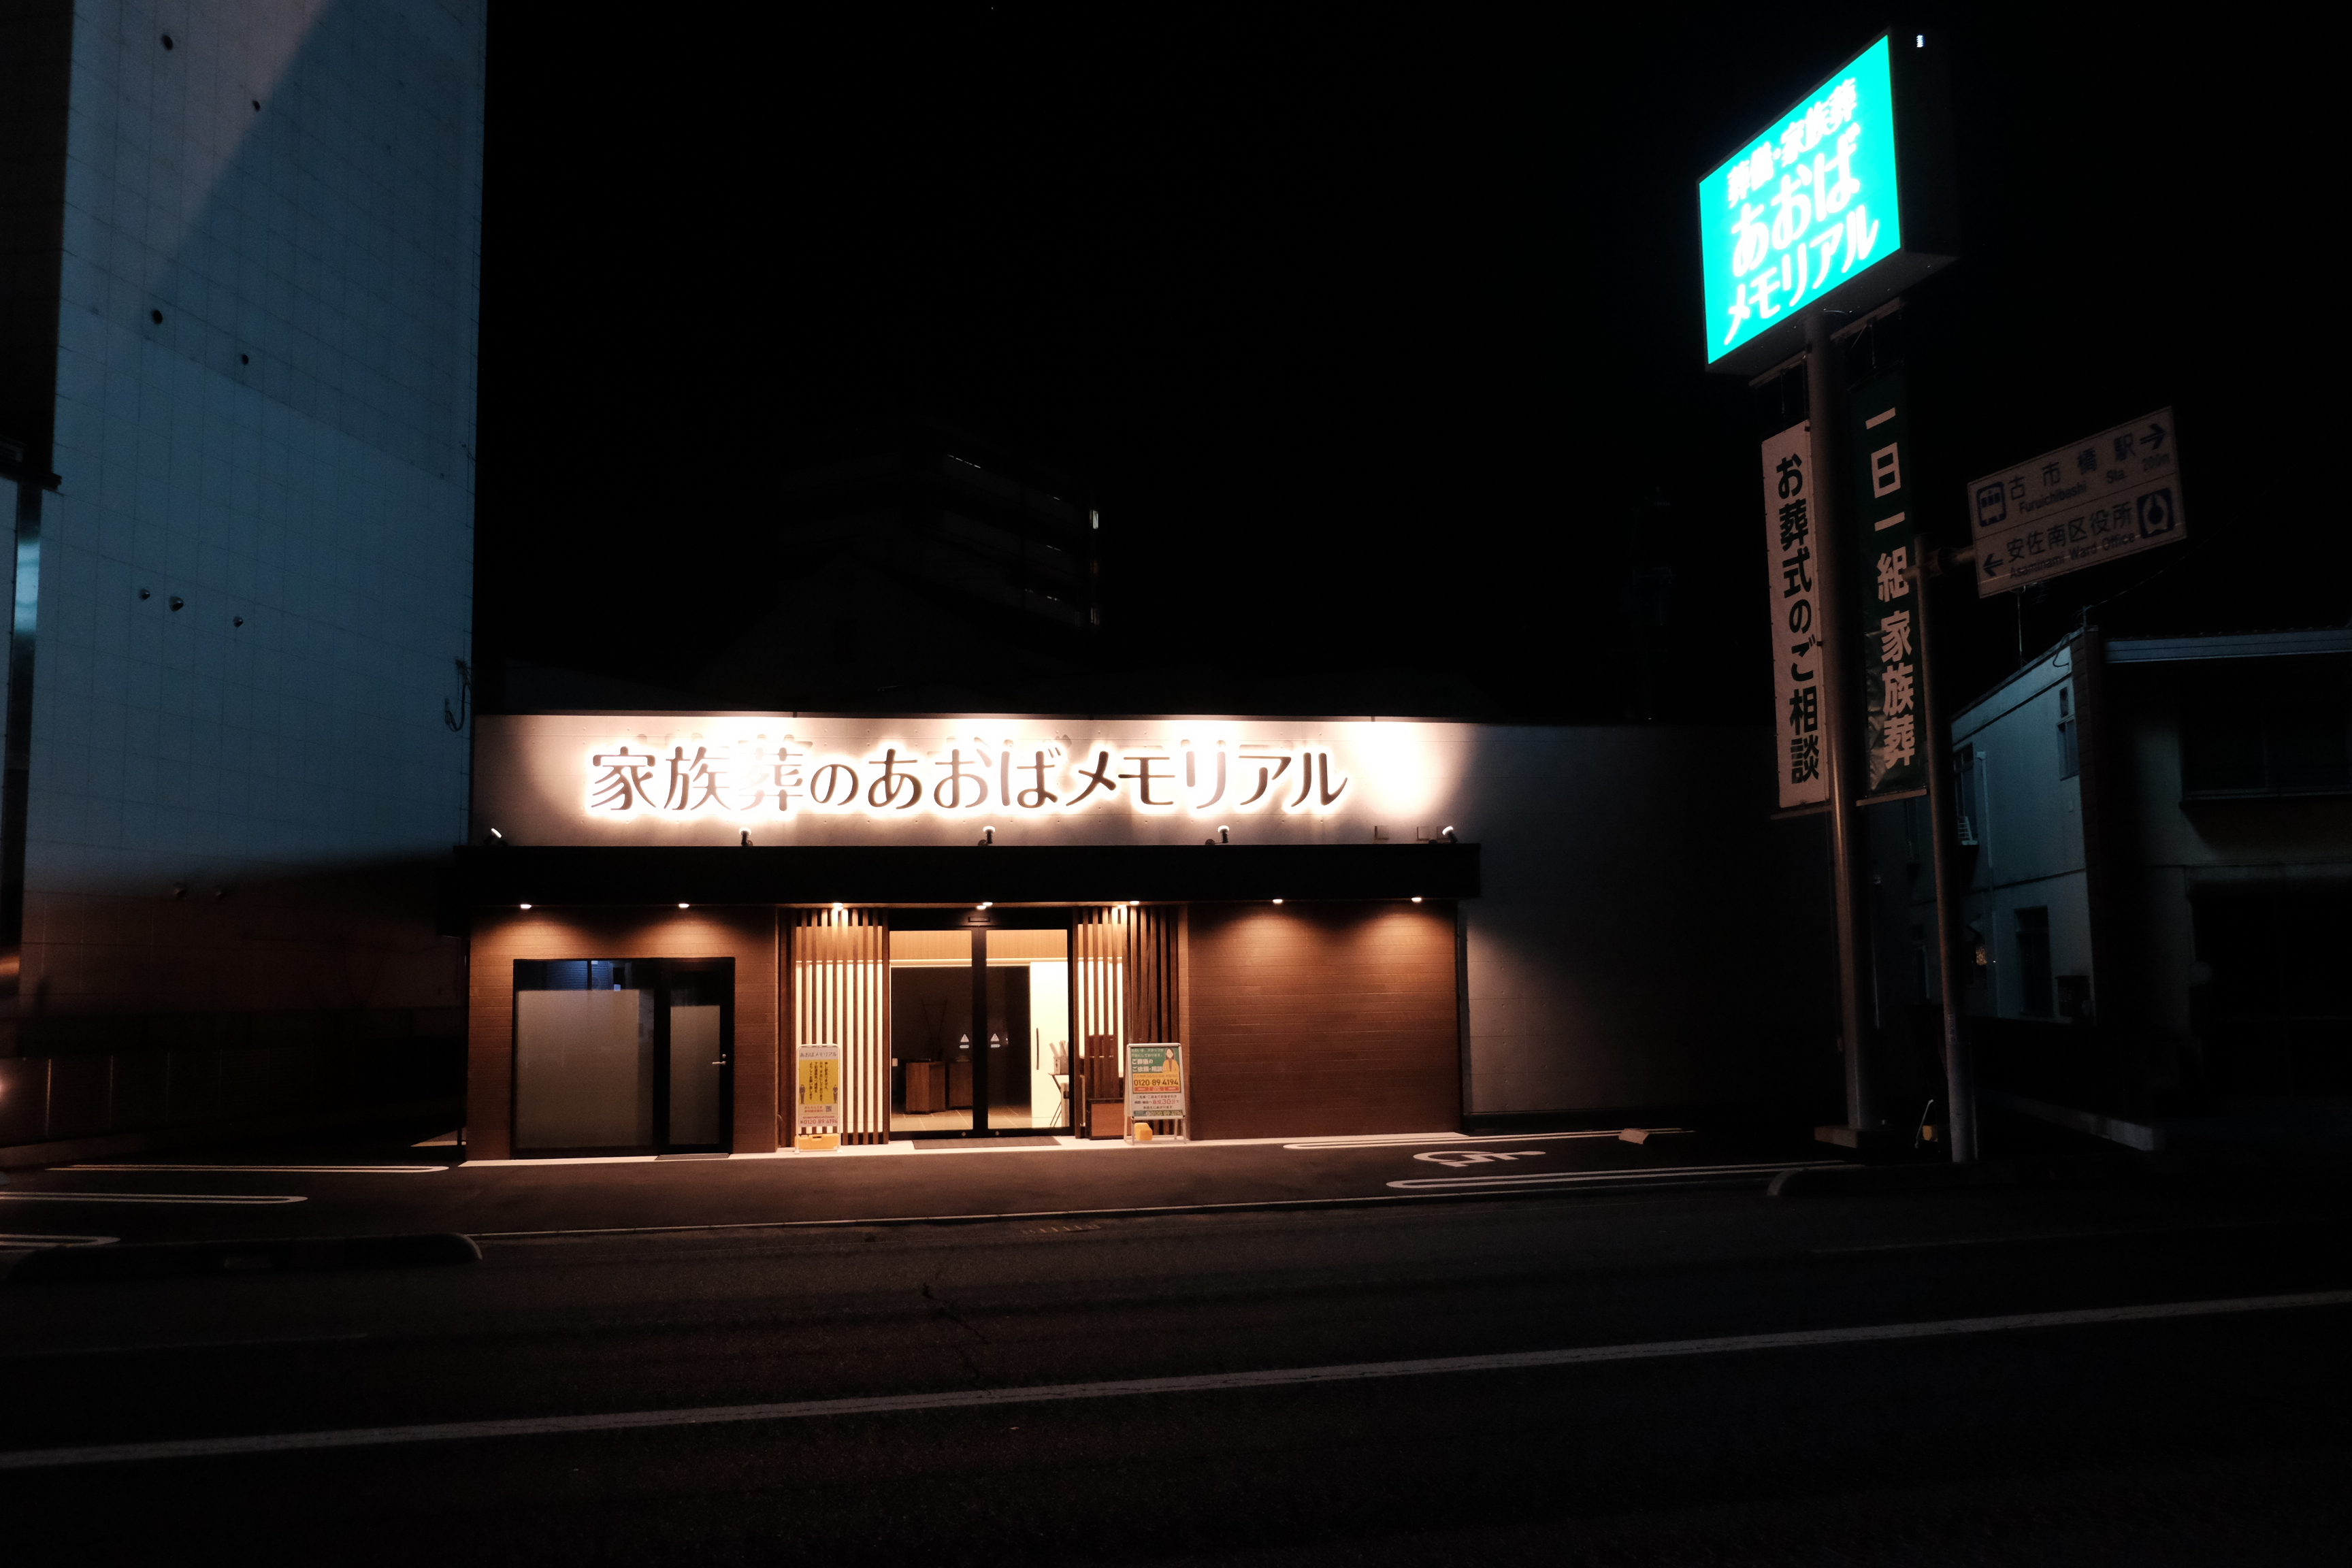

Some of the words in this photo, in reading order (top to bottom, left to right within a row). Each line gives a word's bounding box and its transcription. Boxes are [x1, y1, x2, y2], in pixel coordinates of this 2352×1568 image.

[1727, 77, 1857, 208] 葬・家族葬
[1731, 122, 1861, 277] あおば
[1723, 204, 1880, 346] メモリアル
[2008, 433, 2136, 500] 古市橋駅
[2019, 480, 2087, 514] Furuichibashi
[2007, 502, 2132, 563] 安佐南区役所
[2010, 554, 2065, 578] Asaminami
[2070, 542, 2097, 561] Ward
[2102, 533, 2136, 551] Office
[1776, 453, 1819, 784] お葬式のご相談
[1865, 407, 1916, 769] 一日一組家族葬
[591, 746, 1348, 811] 家族葬のあおばメモリアル
